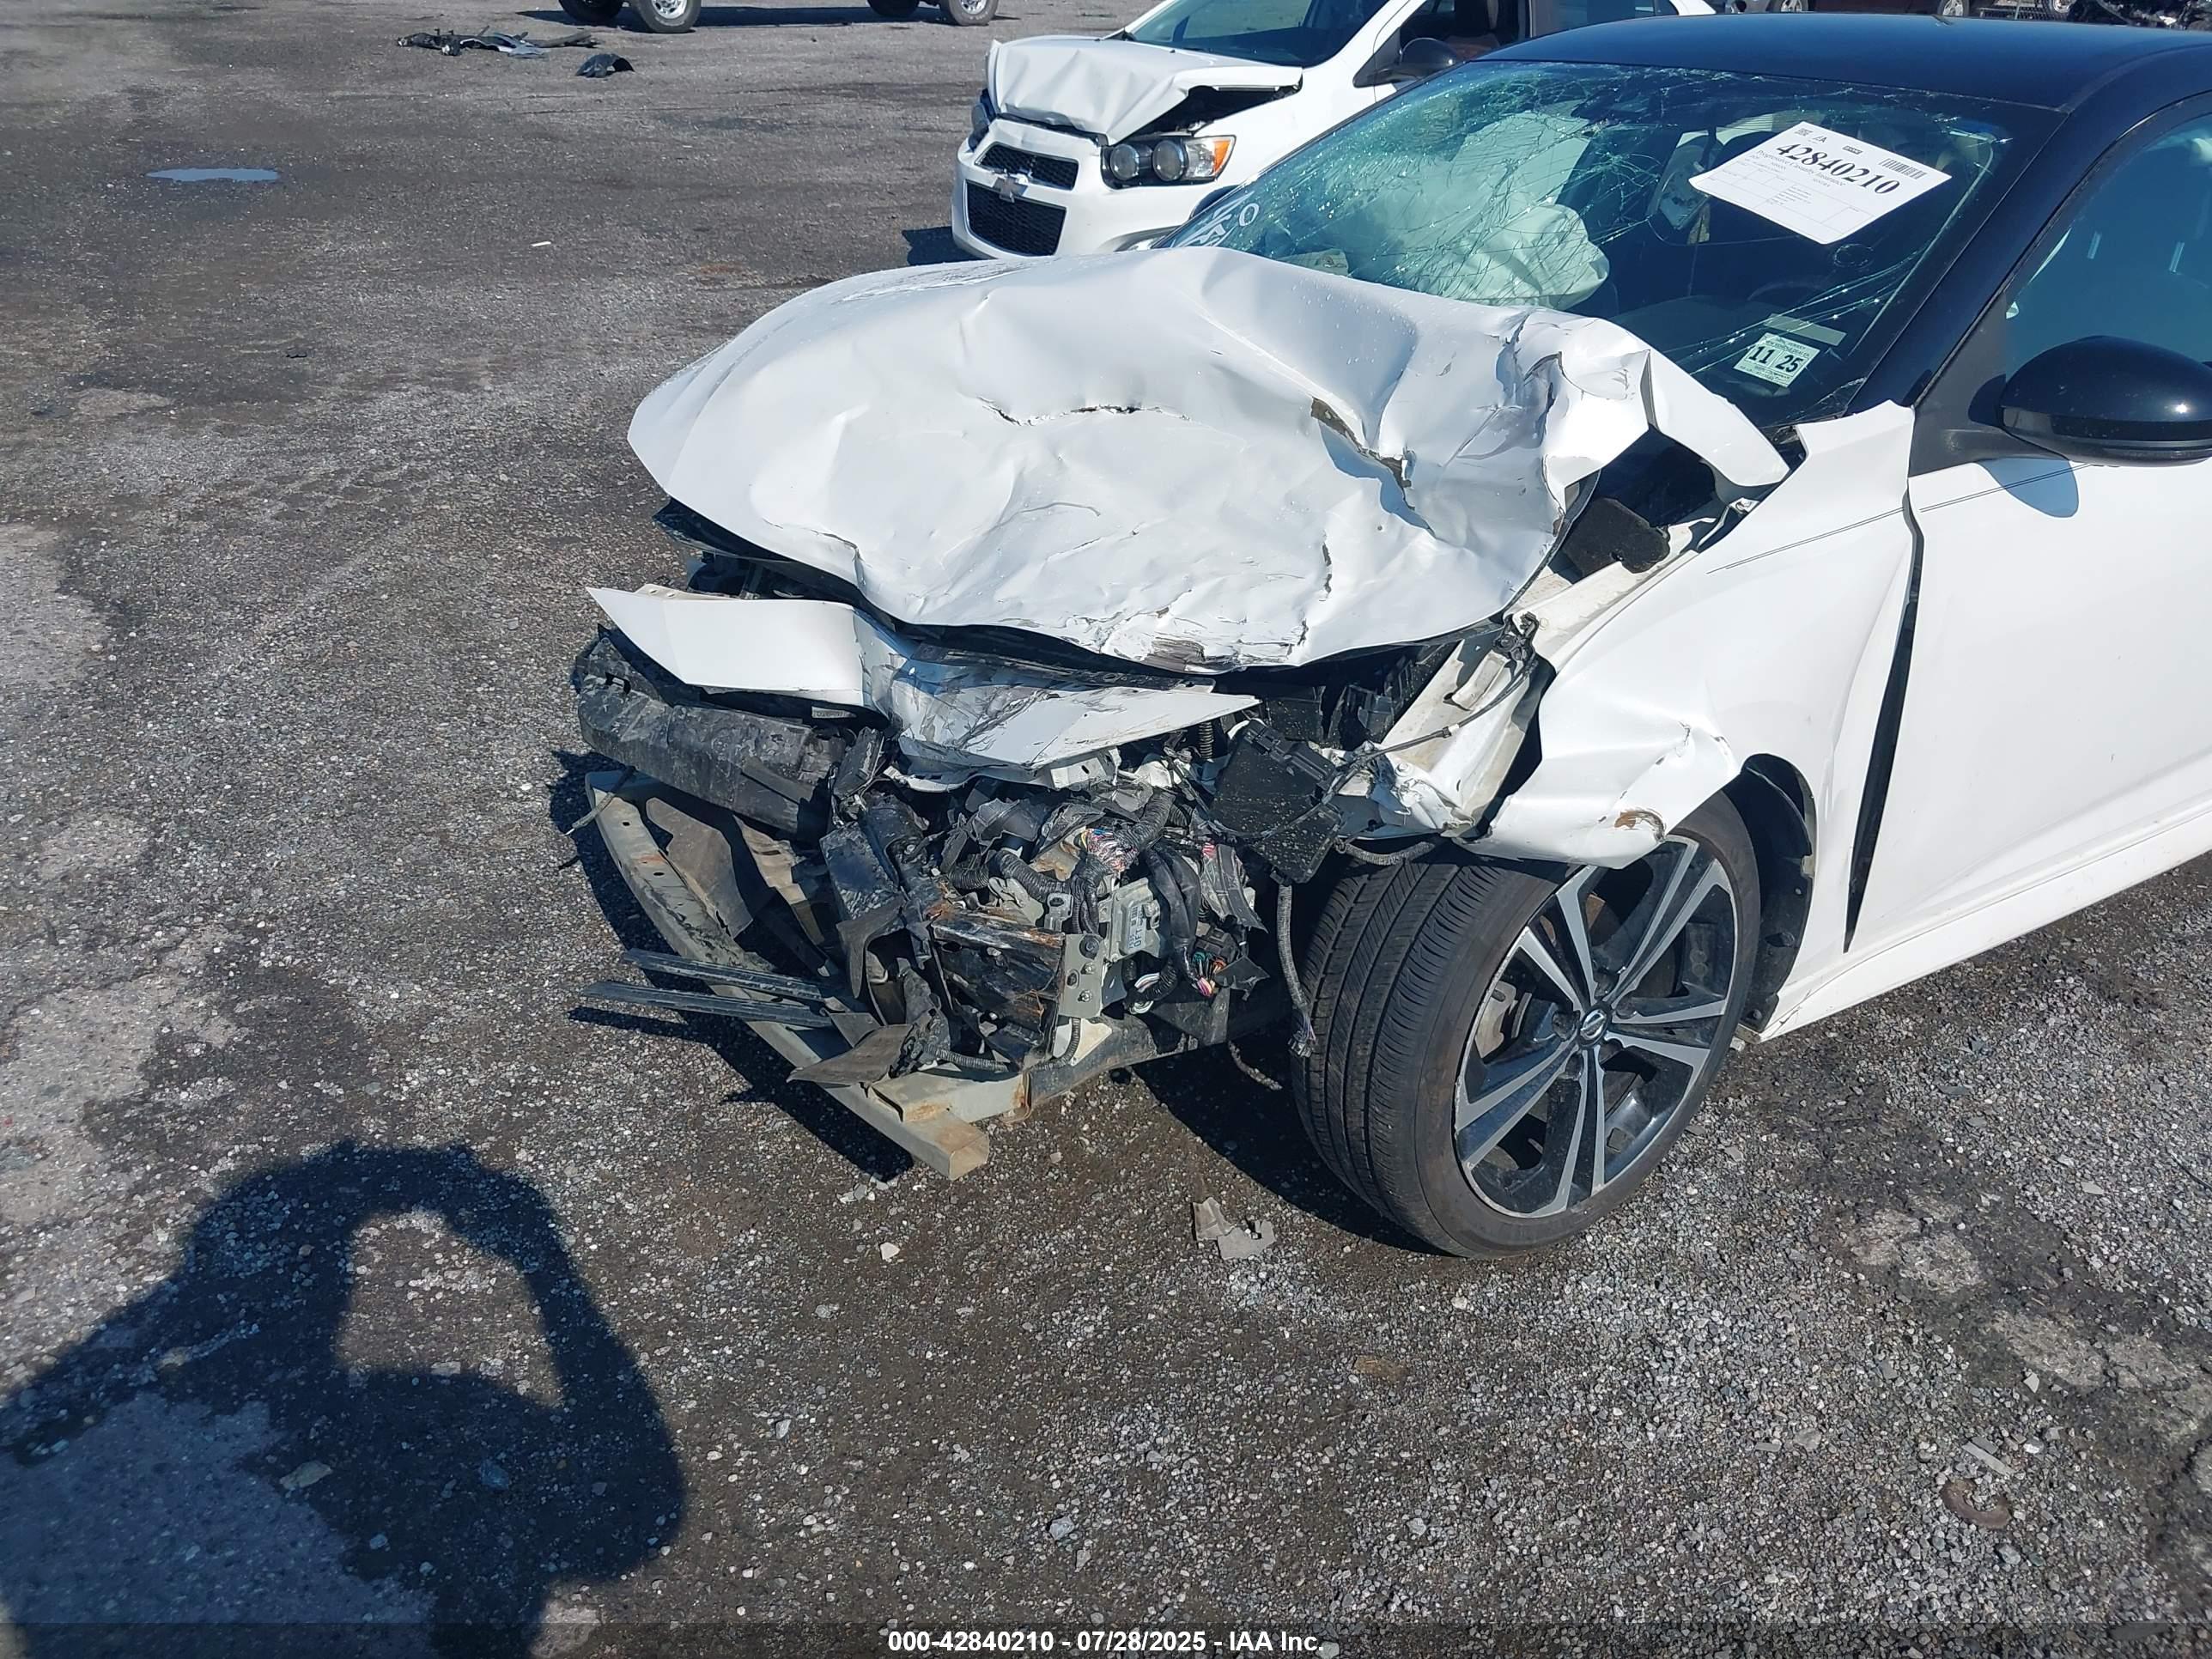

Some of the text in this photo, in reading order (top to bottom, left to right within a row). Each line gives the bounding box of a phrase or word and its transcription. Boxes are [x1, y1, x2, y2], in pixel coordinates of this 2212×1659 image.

[1776, 143, 1900, 194] 42840210
[1748, 346, 1775, 364] 11
[1775, 355, 1803, 373] 25
